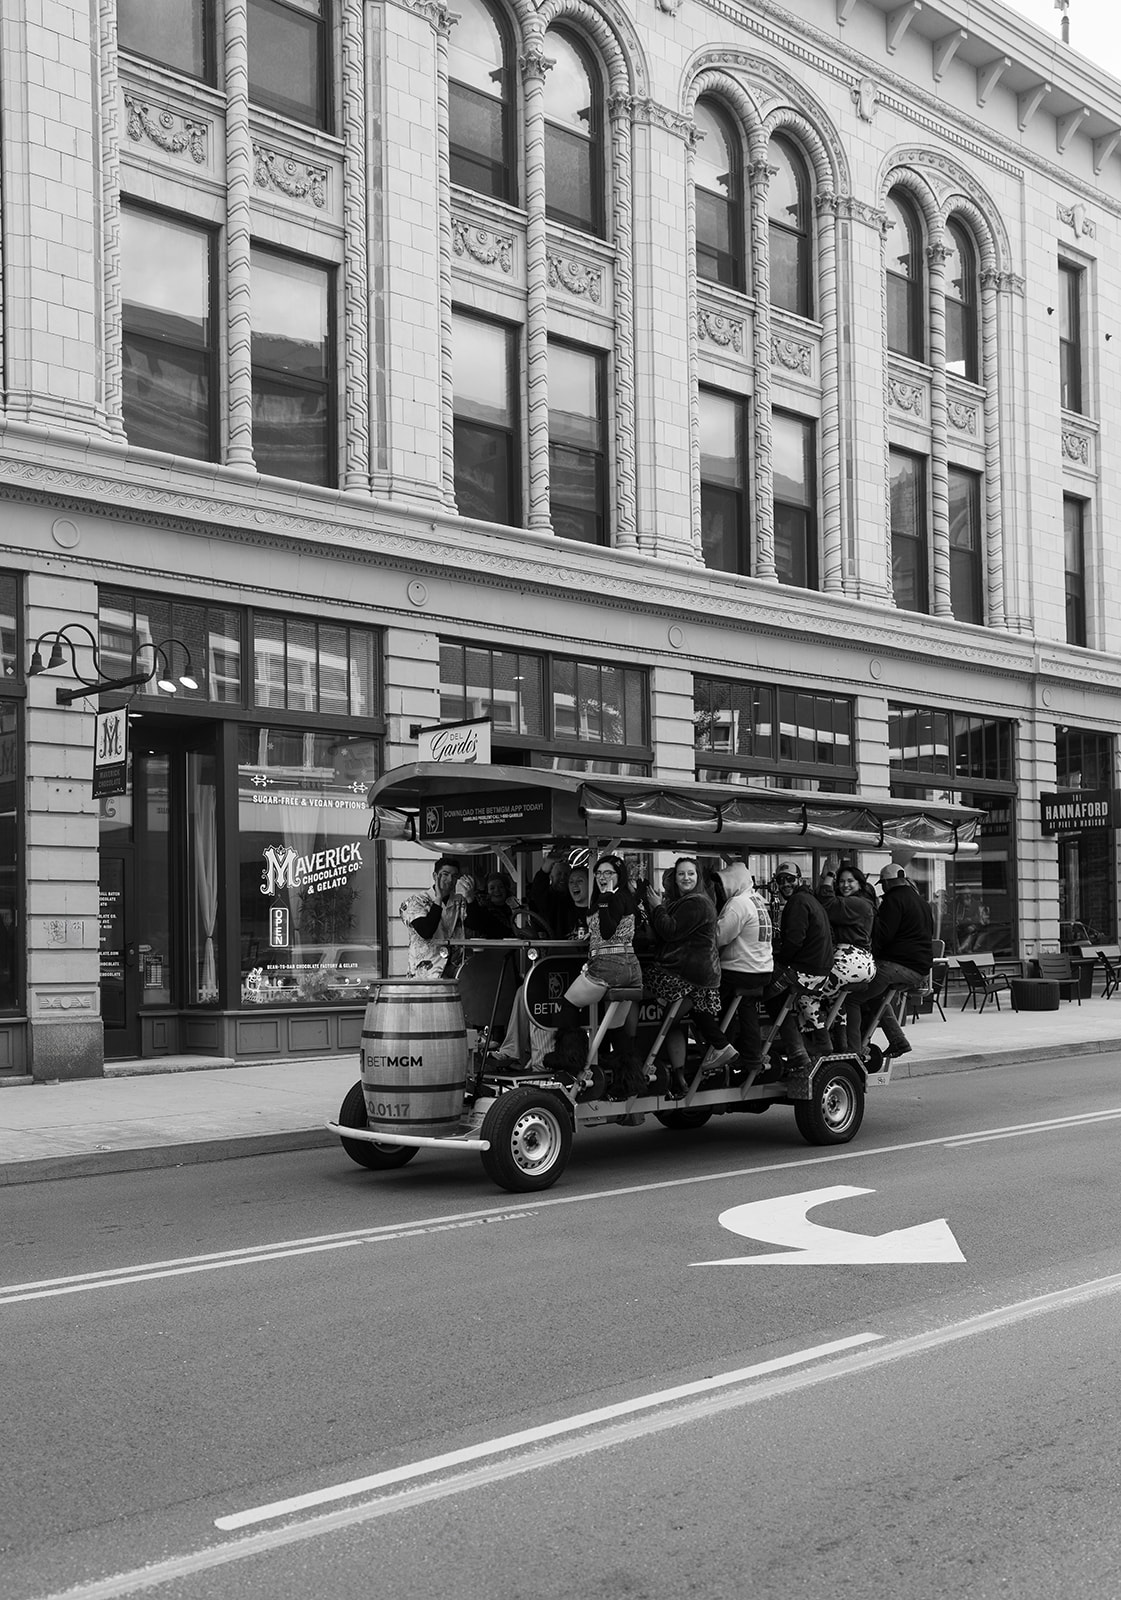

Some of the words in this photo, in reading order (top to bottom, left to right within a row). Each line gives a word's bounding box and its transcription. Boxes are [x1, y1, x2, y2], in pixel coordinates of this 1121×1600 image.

[98, 715, 123, 759] M
[430, 728, 478, 762] Gardo's
[449, 732, 463, 741] DEL
[252, 794, 299, 806] SUGAR-FREE
[300, 798, 307, 806] &
[309, 798, 333, 808] VEGAN
[334, 800, 366, 809] OPTIONS
[1072, 794, 1082, 802] THE
[444, 807, 474, 818] DOWNLOAD
[474, 806, 485, 815] THE
[486, 804, 511, 815] BETMGM
[511, 804, 523, 812] APP
[523, 802, 544, 812] TODAY!
[1045, 801, 1108, 820] HANNAFORD
[1080, 818, 1105, 827] MADISON
[260, 841, 363, 896] MAVERICK
[302, 866, 348, 885] CHOCOLATE
[307, 882, 315, 894] &
[317, 876, 348, 892] GELATO
[275, 909, 283, 945] OPEN
[534, 1002, 562, 1015] BETM
[367, 1055, 423, 1067] BETMGM
